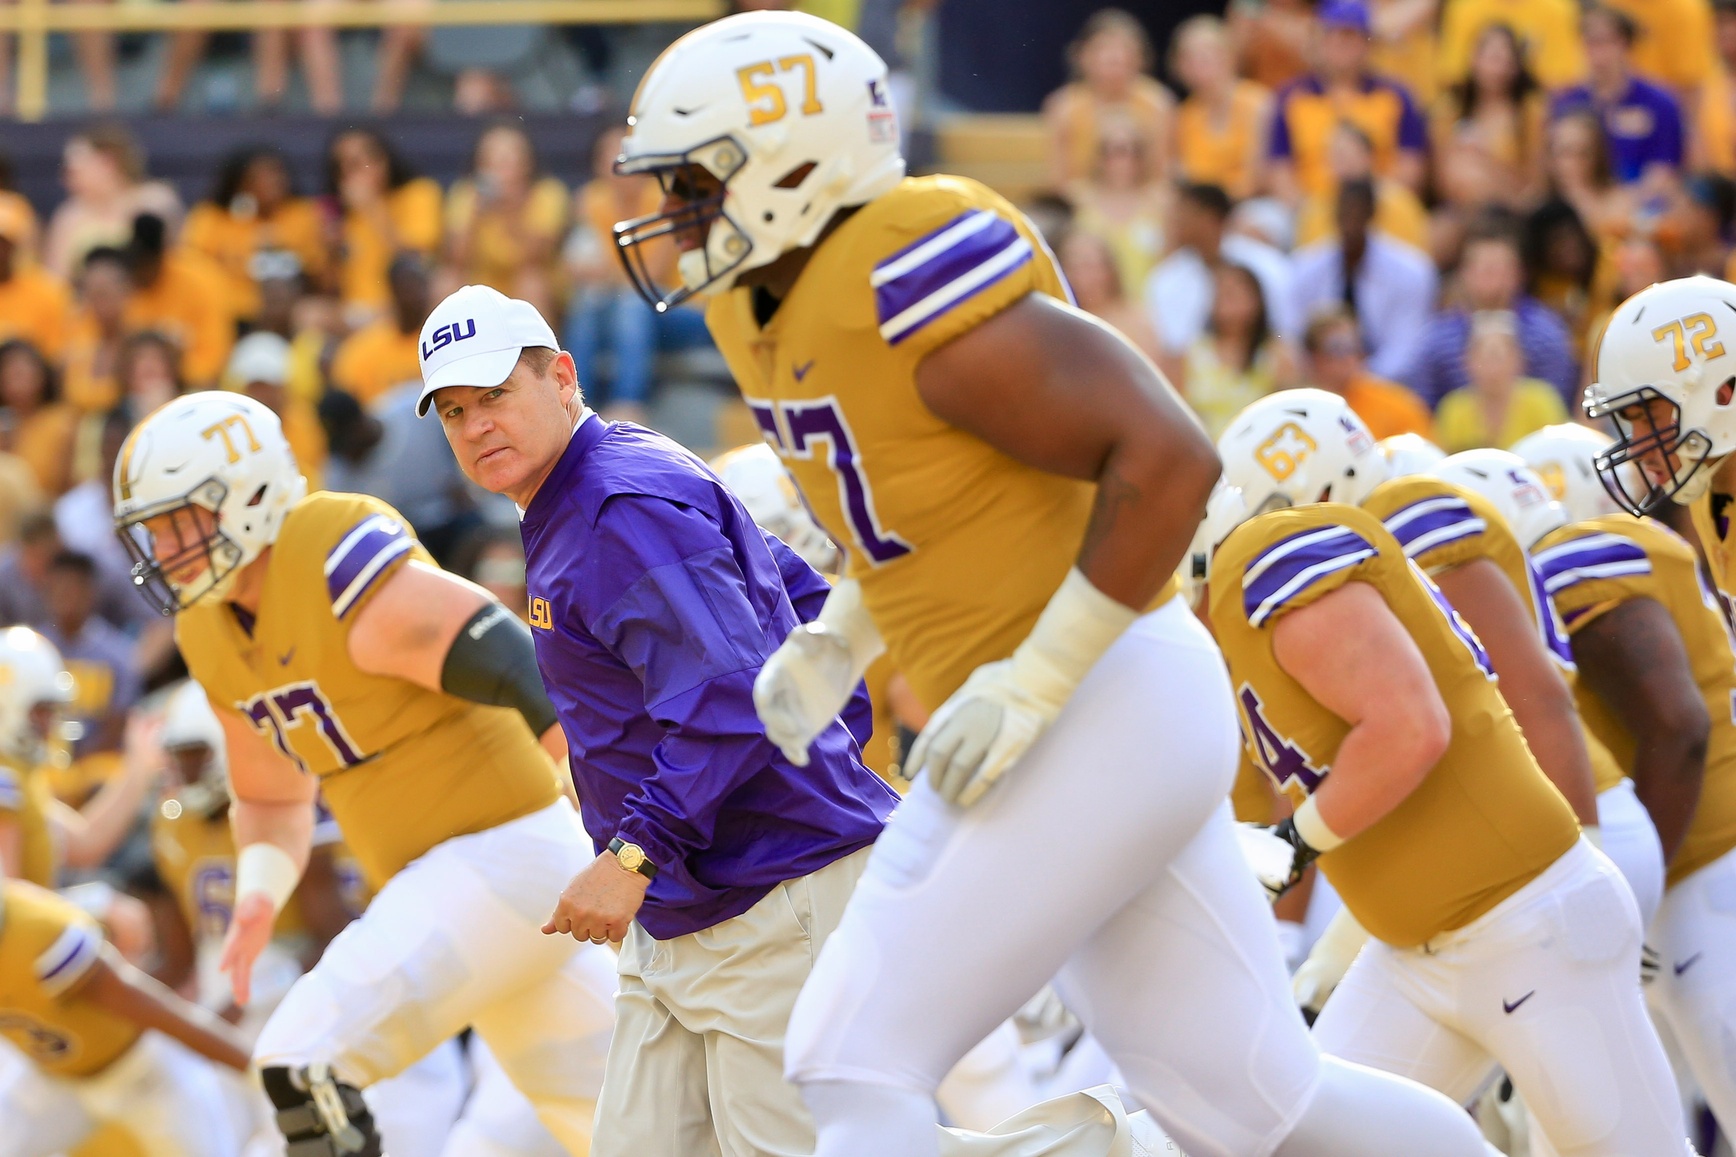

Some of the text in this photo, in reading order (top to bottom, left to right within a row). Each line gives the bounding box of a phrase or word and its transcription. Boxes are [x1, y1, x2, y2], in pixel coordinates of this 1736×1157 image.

[736, 54, 823, 128] 57
[422, 318, 476, 361] LSU
[1651, 311, 1726, 373] 72
[201, 413, 262, 464] 77
[1254, 421, 1317, 482] 63
[528, 594, 554, 630] LSU
[1236, 681, 1331, 796] 4
